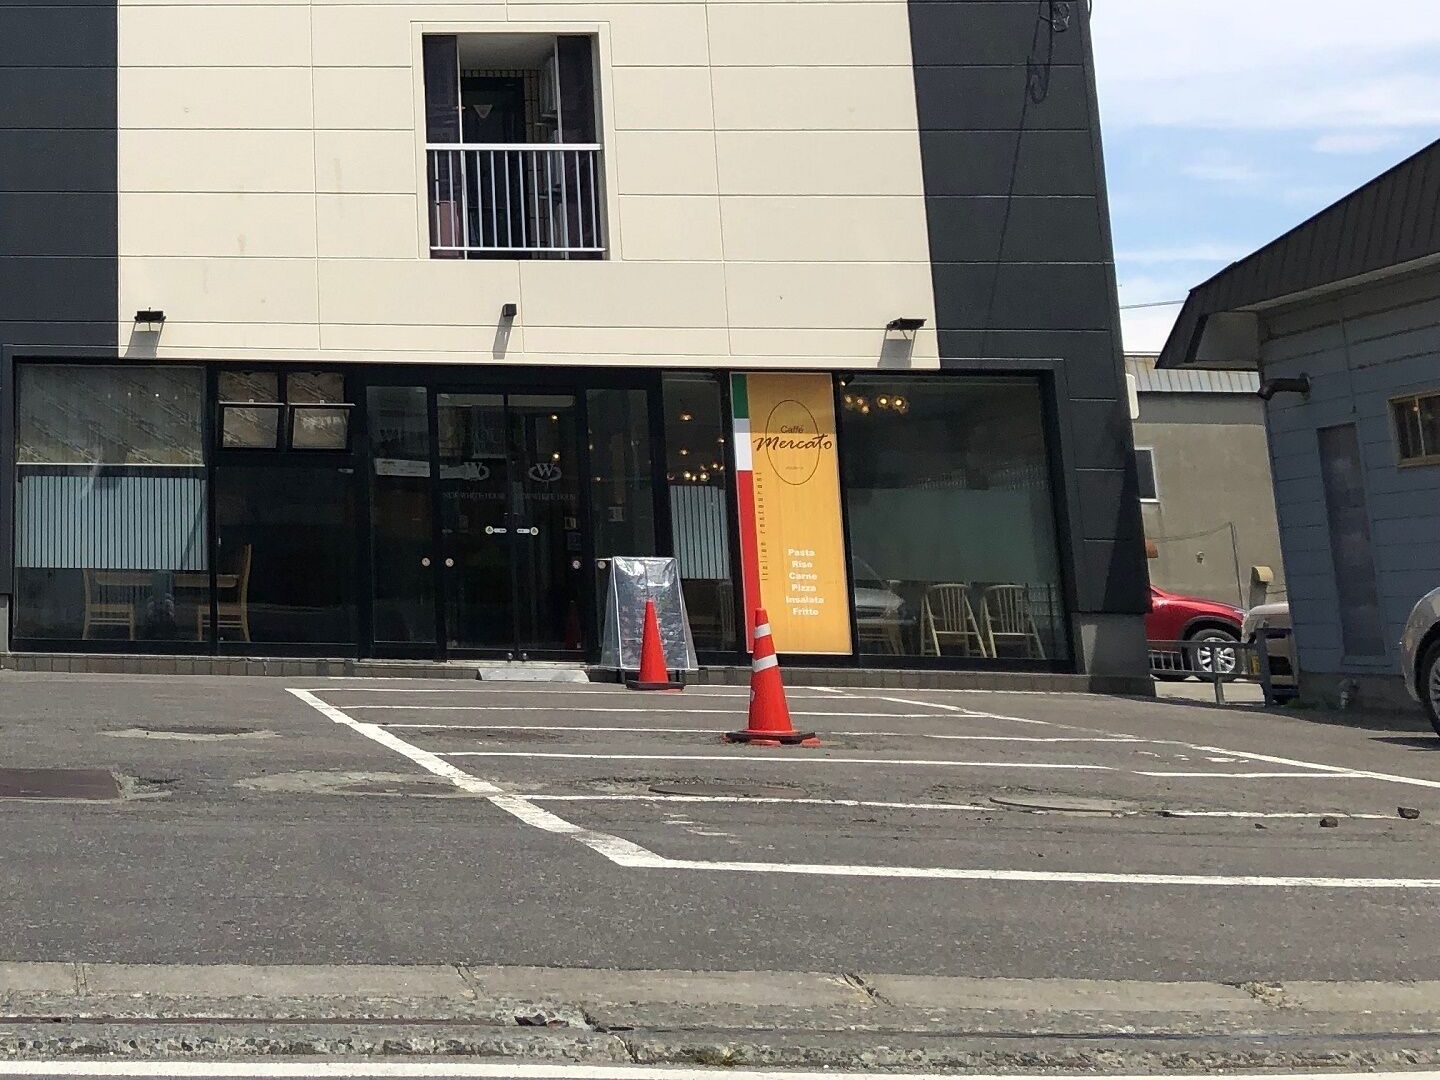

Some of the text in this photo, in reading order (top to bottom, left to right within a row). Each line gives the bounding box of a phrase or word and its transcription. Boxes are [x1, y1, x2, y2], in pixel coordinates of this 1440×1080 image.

[752, 433, 833, 452] Mercato
[788, 548, 816, 557] Pasta
[791, 560, 813, 568] Riso
[788, 572, 818, 580] Carne
[791, 583, 817, 592] Pizza
[785, 595, 825, 604] Insalata
[792, 607, 819, 616] Fritto
